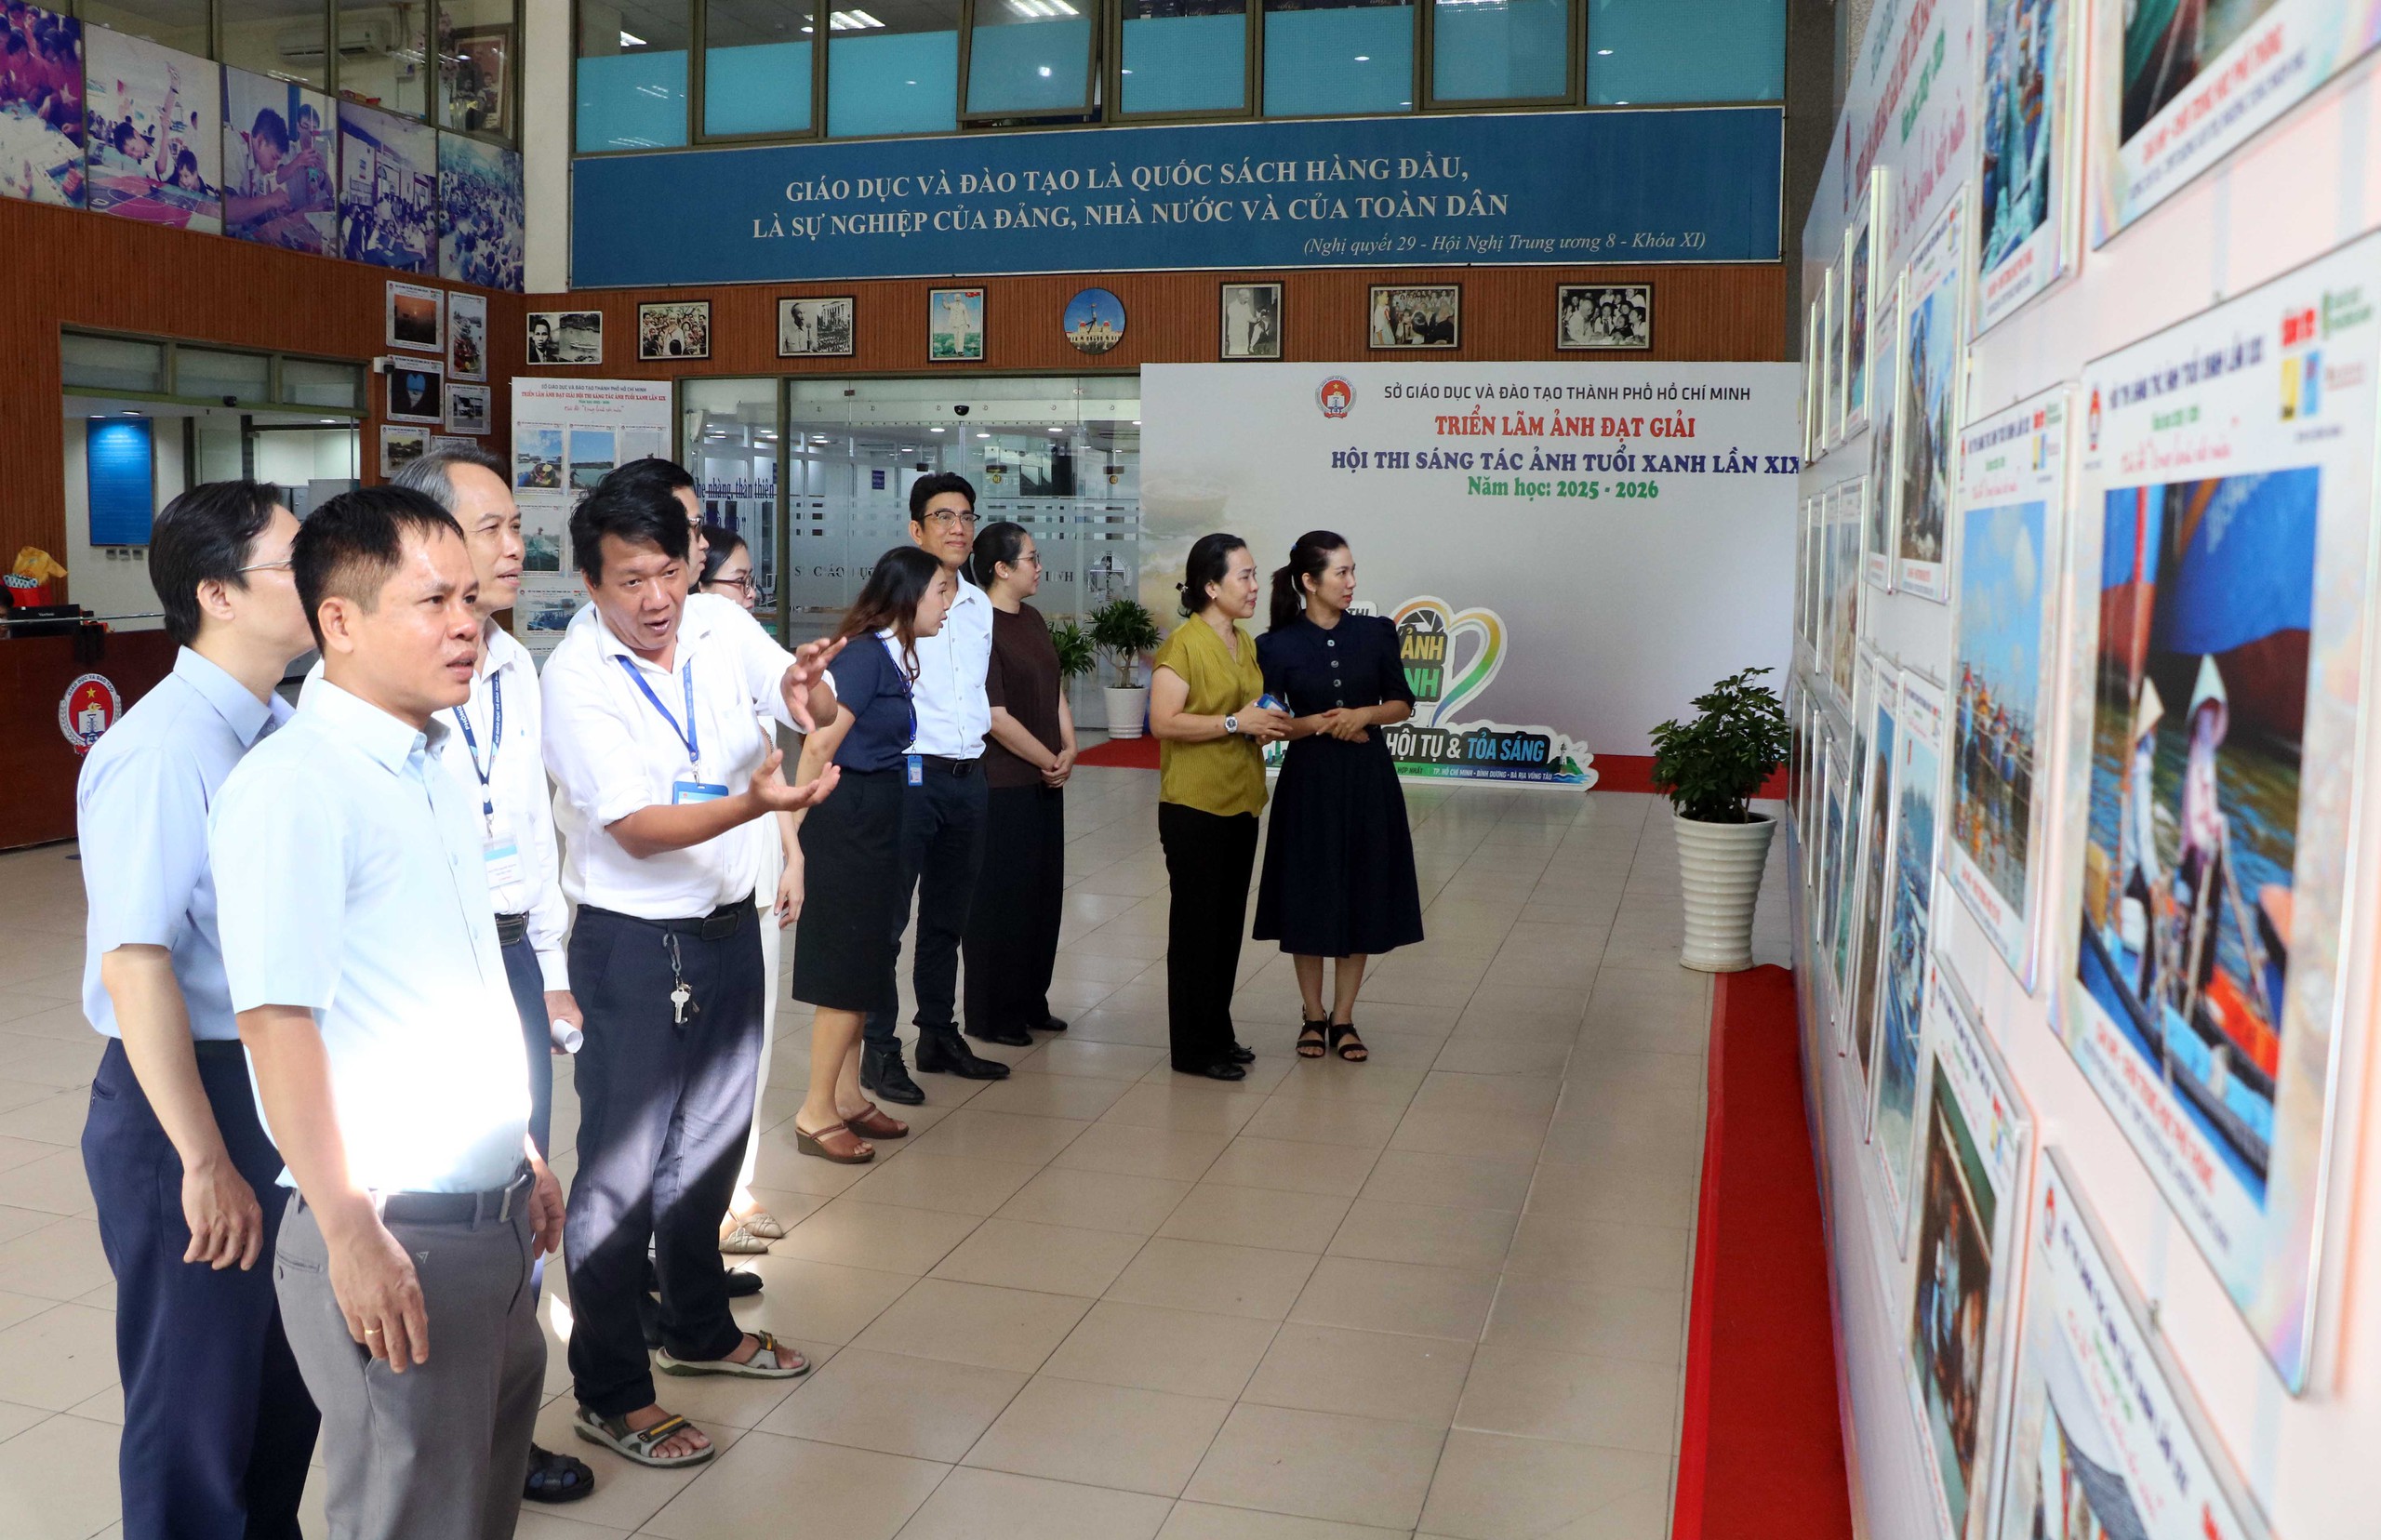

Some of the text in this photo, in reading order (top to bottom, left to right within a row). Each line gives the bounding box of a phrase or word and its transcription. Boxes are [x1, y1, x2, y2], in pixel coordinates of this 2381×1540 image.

[786, 152, 1468, 202] GIÁO DỤC VÀ ĐÀO TẠO LÀ QUỐC SÁCH HÀNG ĐẦU,
[752, 189, 1508, 241] LÀ SỰ NGHIỆP CỦA ĐẢNG, NHÀ NƯỚC VÀ CỦA TOÀN DÂN
[1305, 238, 1346, 256] (Nghị
[1351, 232, 1392, 256] quyết
[1397, 236, 1416, 250] 29
[1432, 236, 1460, 253] Hội
[1466, 235, 1503, 253] Nghị
[1510, 235, 1555, 252] Trung
[1560, 238, 1602, 252] ương
[1606, 233, 1616, 247] 8
[1632, 232, 1675, 247] Khóa
[1680, 232, 1705, 250] XI)
[1384, 382, 1749, 403] SỞ GIÁO DỤC VÀ ĐÀO TẠO THÀNH PHỐ HỒ CHÍ MINH
[1434, 404, 1696, 442] TRIỂN LÃM ẢNH ĐẠT GIẢI
[1332, 445, 1799, 474] HỘI THI SÁNG TÁC ẢNH TUỔI XANH LẦN XIX
[1469, 476, 1509, 496] Năm
[1513, 475, 1551, 503] học:
[1556, 477, 1600, 499] 2025
[1616, 481, 1659, 498] 2026
[1400, 628, 1444, 660] ẢNH
[1387, 729, 1545, 763] HỘI TỤ & TỎA SÁNG
